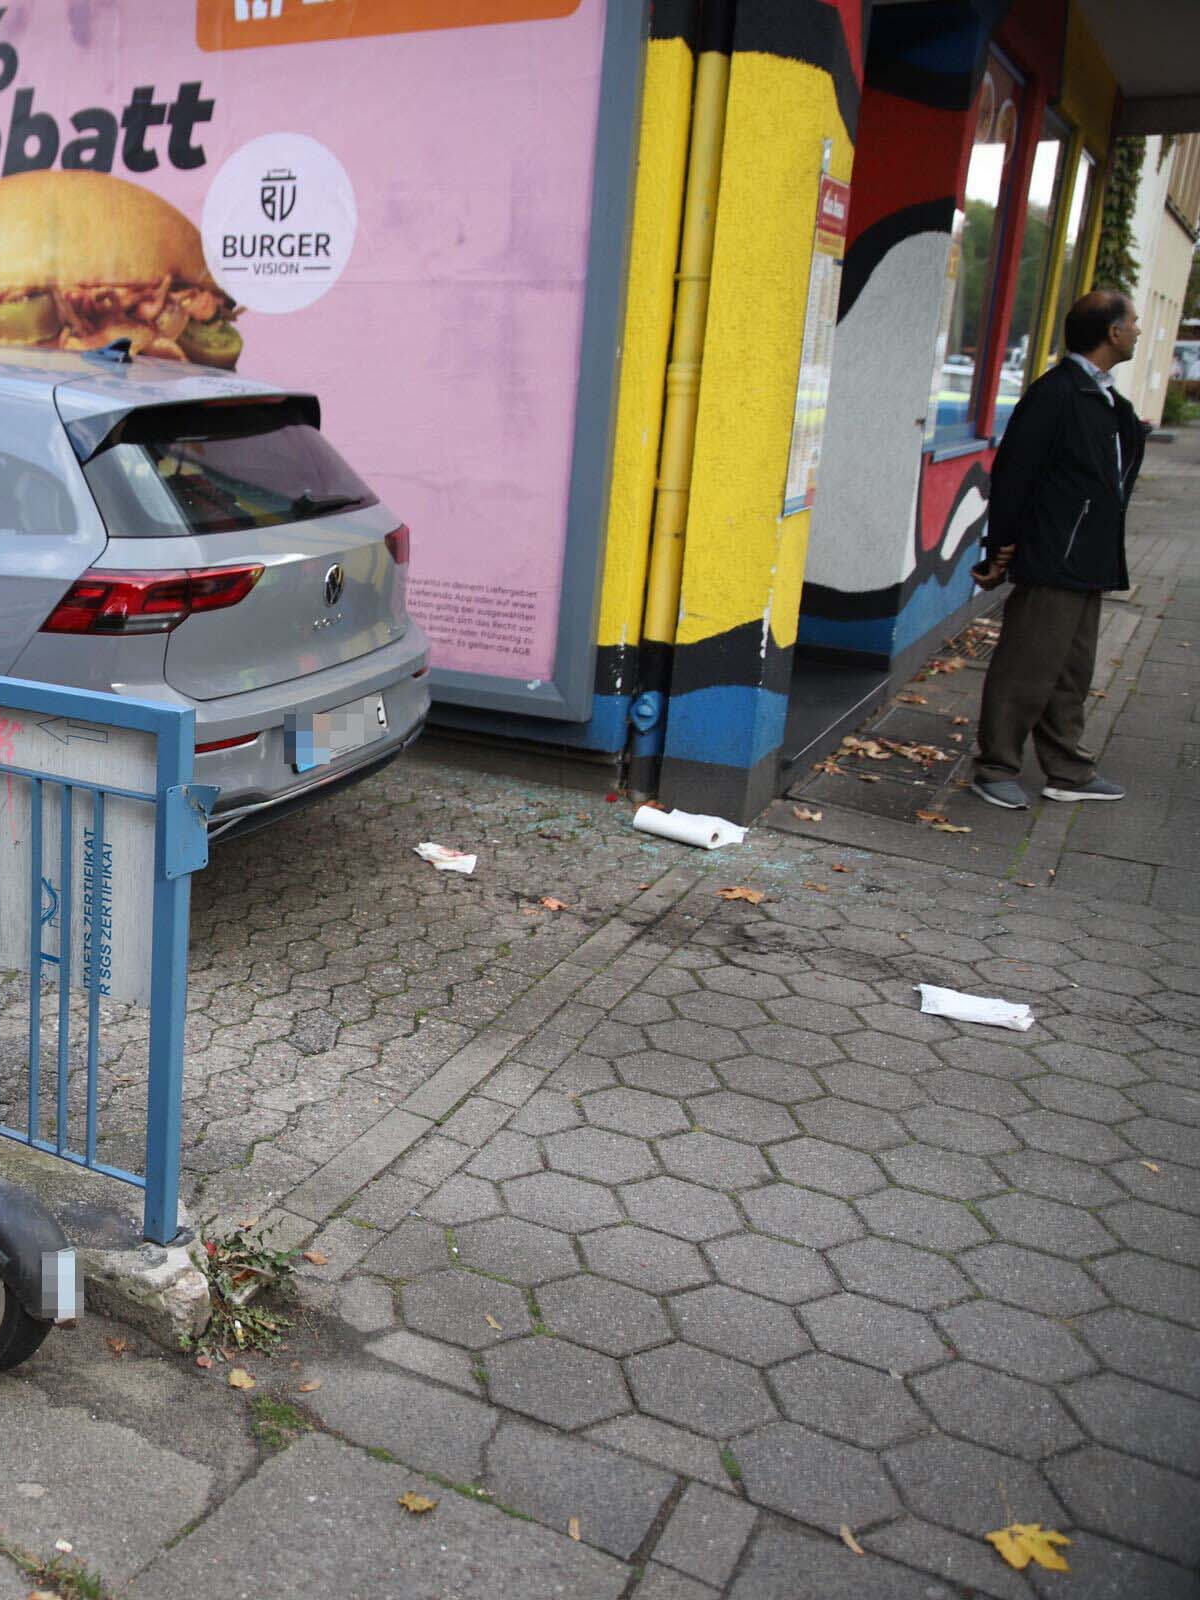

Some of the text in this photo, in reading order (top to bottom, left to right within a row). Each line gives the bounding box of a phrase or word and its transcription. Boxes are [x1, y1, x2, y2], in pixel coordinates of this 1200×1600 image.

[222, 232, 331, 259] BURGER
[253, 261, 300, 276] VISION
[100, 842, 113, 940] ZERTIFIKAT
[99, 943, 112, 979] SGS
